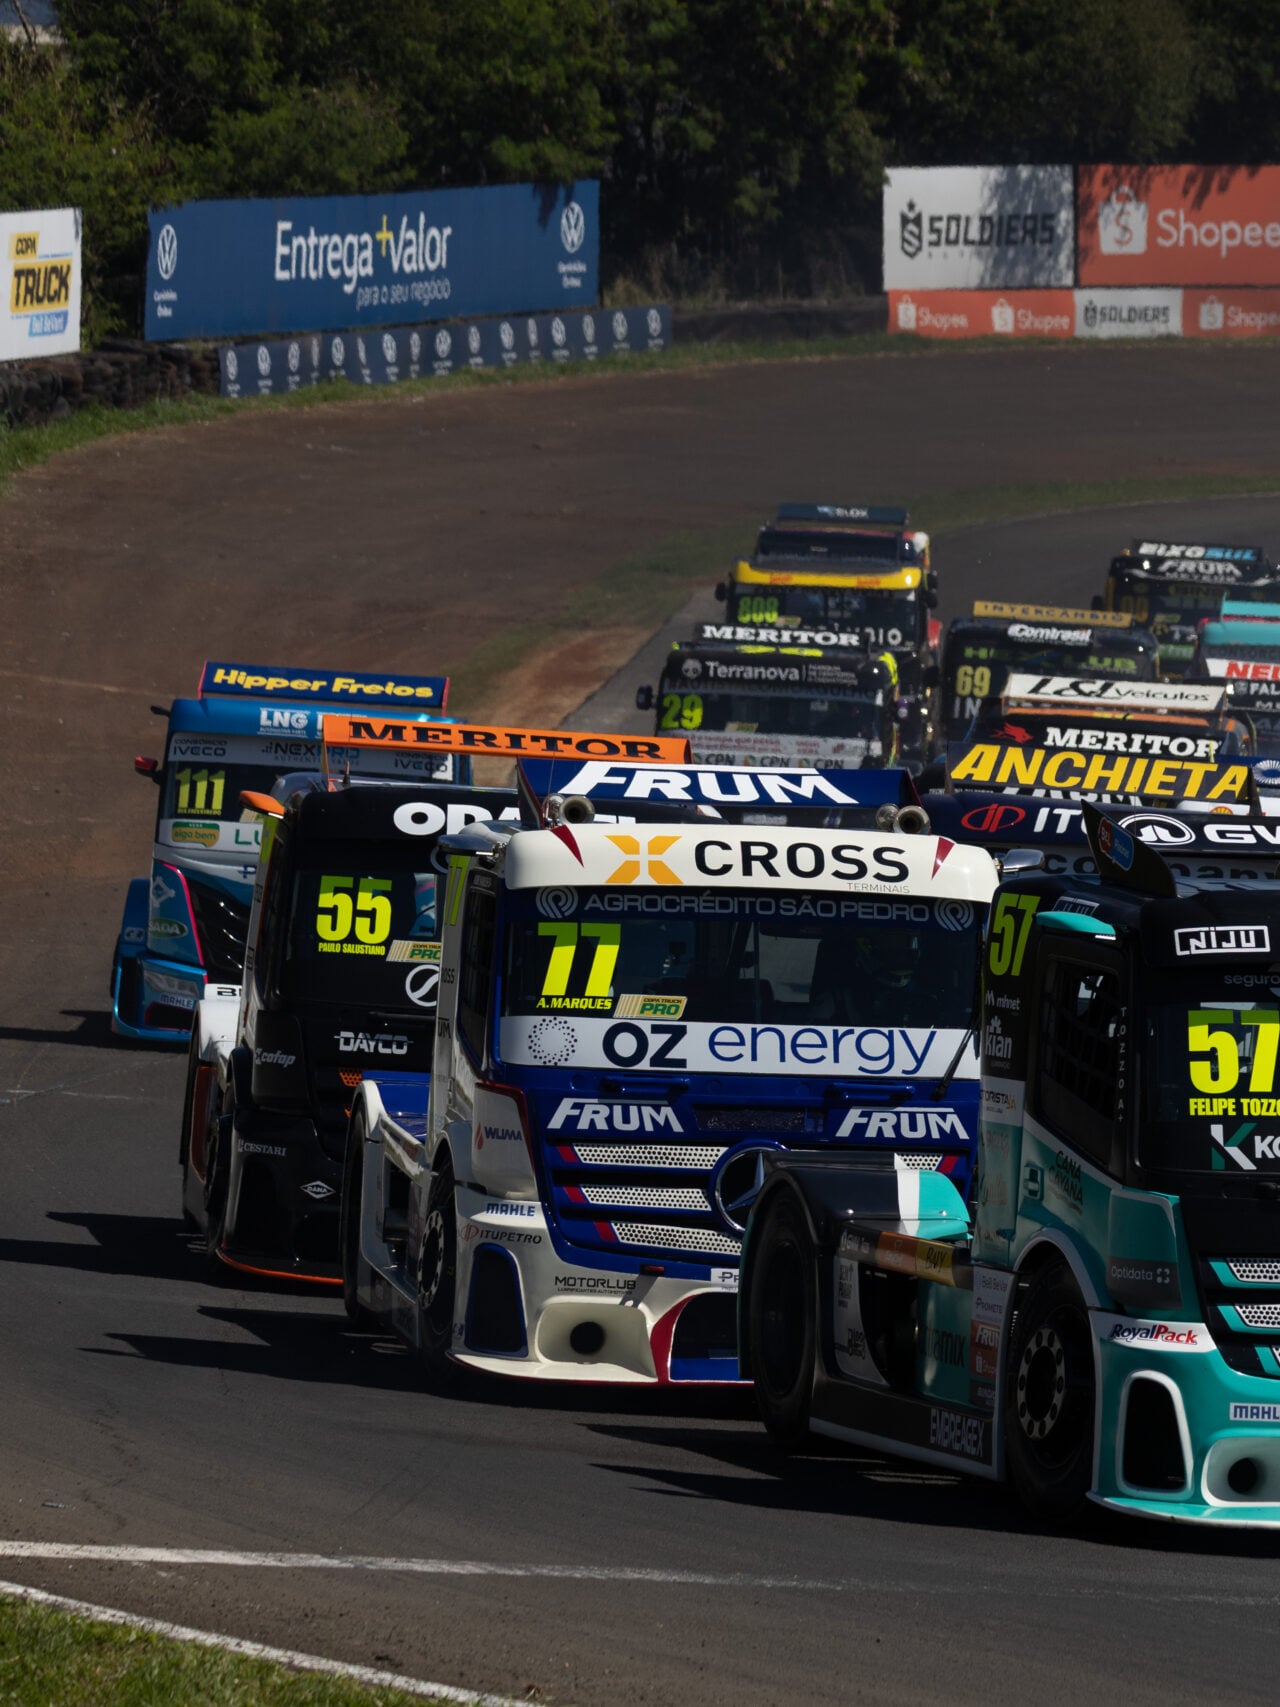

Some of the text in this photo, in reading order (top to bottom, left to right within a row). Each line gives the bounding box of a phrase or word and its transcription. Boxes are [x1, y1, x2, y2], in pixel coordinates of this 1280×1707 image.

[928, 213, 1057, 247] SOLDIERS
[15, 237, 37, 256] COPA
[13, 263, 71, 308] TRUCK
[357, 277, 452, 311] para o seu negócio
[918, 306, 969, 330] Shopee
[1016, 308, 1070, 333] Shopee
[1099, 304, 1171, 324] SOLDIERS
[701, 623, 861, 647] MERITOR
[212, 667, 434, 699] Hipper Freios
[705, 660, 800, 681] Terranova
[956, 664, 991, 697] 69
[259, 709, 309, 729] LNG
[660, 693, 704, 730] 29
[173, 745, 227, 758] IVECO
[348, 720, 667, 761] MERITOR
[1043, 725, 1222, 758] MERITOR
[394, 758, 449, 773] IVECO
[950, 742, 1250, 800] ANCHIETA
[175, 767, 226, 811] 111
[562, 760, 860, 805] FRUM
[694, 840, 909, 884] CROSS
[847, 882, 911, 894] TERMINAIS
[315, 874, 393, 945] 55
[583, 889, 931, 922] AGROCRÉDITO SÃO PEDRO
[988, 892, 1042, 977] 57
[317, 942, 386, 956] PAULO SALUSTIANO
[537, 921, 622, 998] 77
[159, 993, 193, 1010] MAHLE
[536, 996, 614, 1011] A.MARQUES
[640, 1003, 680, 1016] PRO
[338, 1029, 409, 1056] DAYCO
[603, 1021, 937, 1076] OZ energy
[1187, 1009, 1280, 1095] 57
[261, 1050, 296, 1068] cofap
[546, 1097, 685, 1133] FRUM
[1188, 1097, 1237, 1117] FELIPE
[835, 1105, 970, 1140] FRUM
[244, 1142, 287, 1157] CESTARI
[486, 1202, 536, 1218] MAHLE
[479, 1231, 543, 1245] ITUPETRO
[555, 1275, 637, 1291] MOTORLUB
[1111, 1265, 1154, 1283] Optidata
[1110, 1322, 1199, 1347] RoyalPack
[930, 1407, 985, 1458] EMBREAGEX
